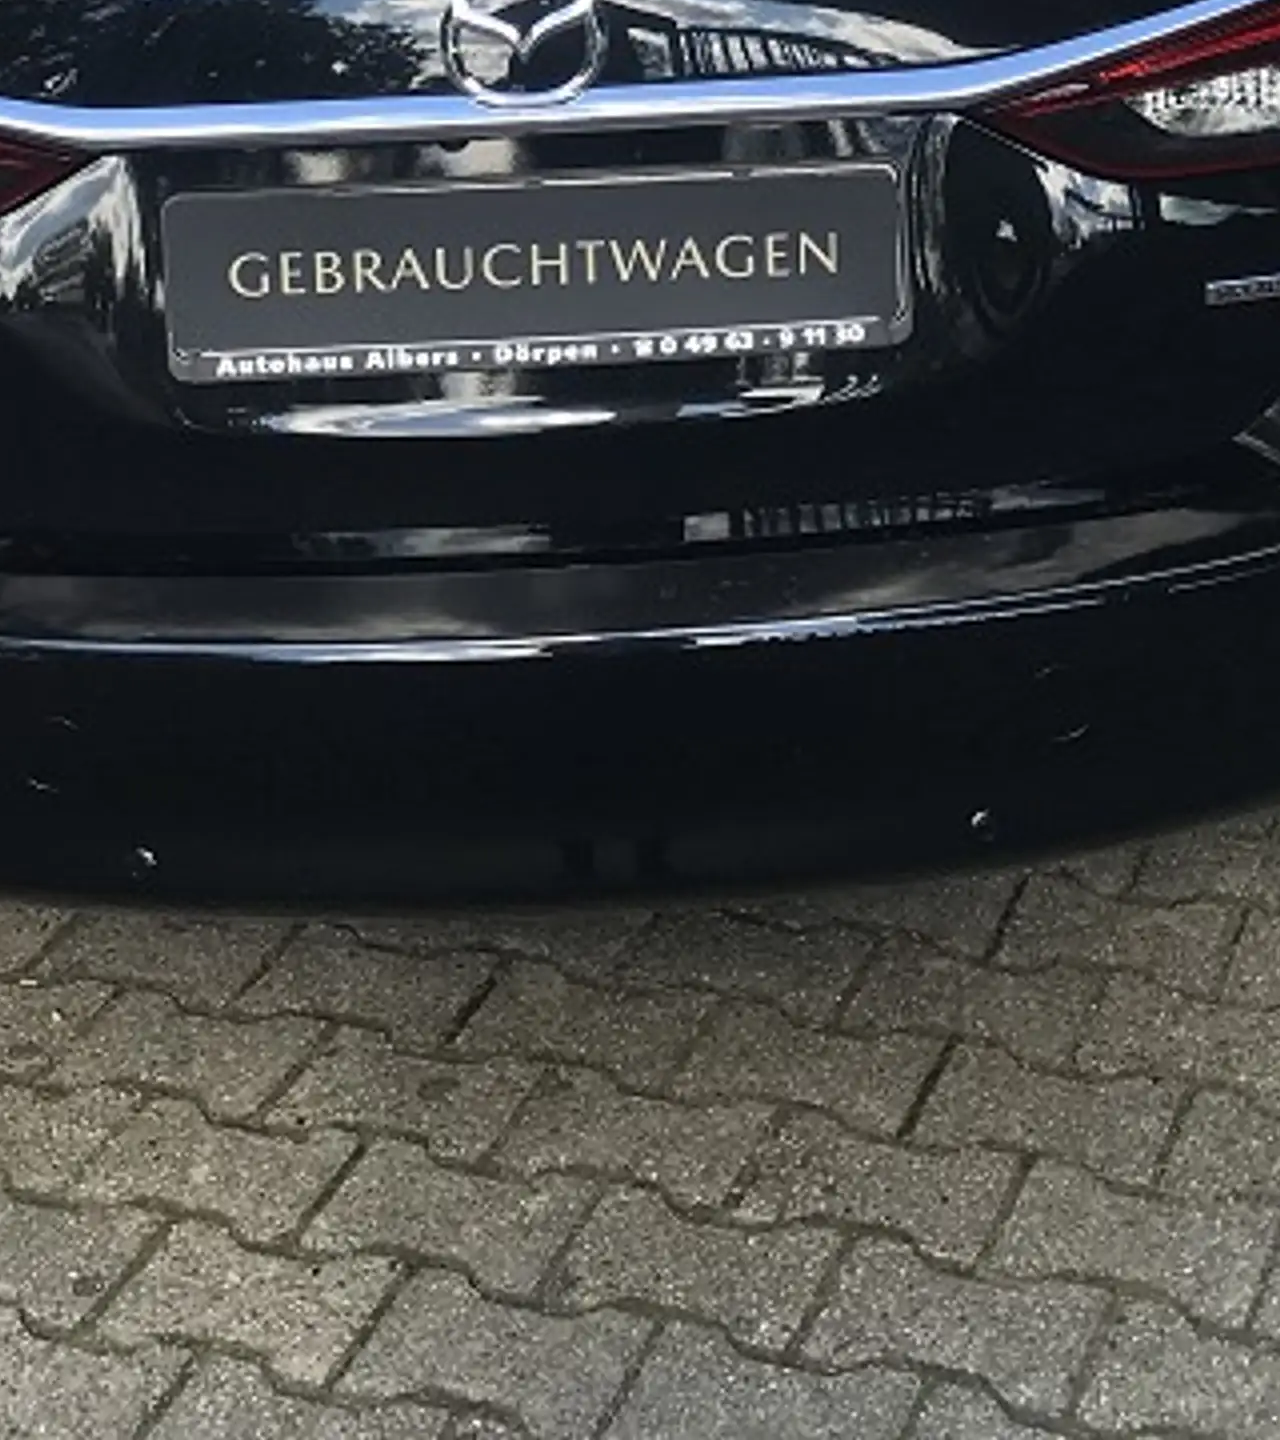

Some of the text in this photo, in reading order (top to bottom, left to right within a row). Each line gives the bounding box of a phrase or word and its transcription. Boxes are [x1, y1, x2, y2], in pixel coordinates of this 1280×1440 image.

[227, 231, 840, 298] GEBRAUCHTWAGEN
[216, 354, 353, 377] Autohaus
[365, 347, 458, 369] Albers
